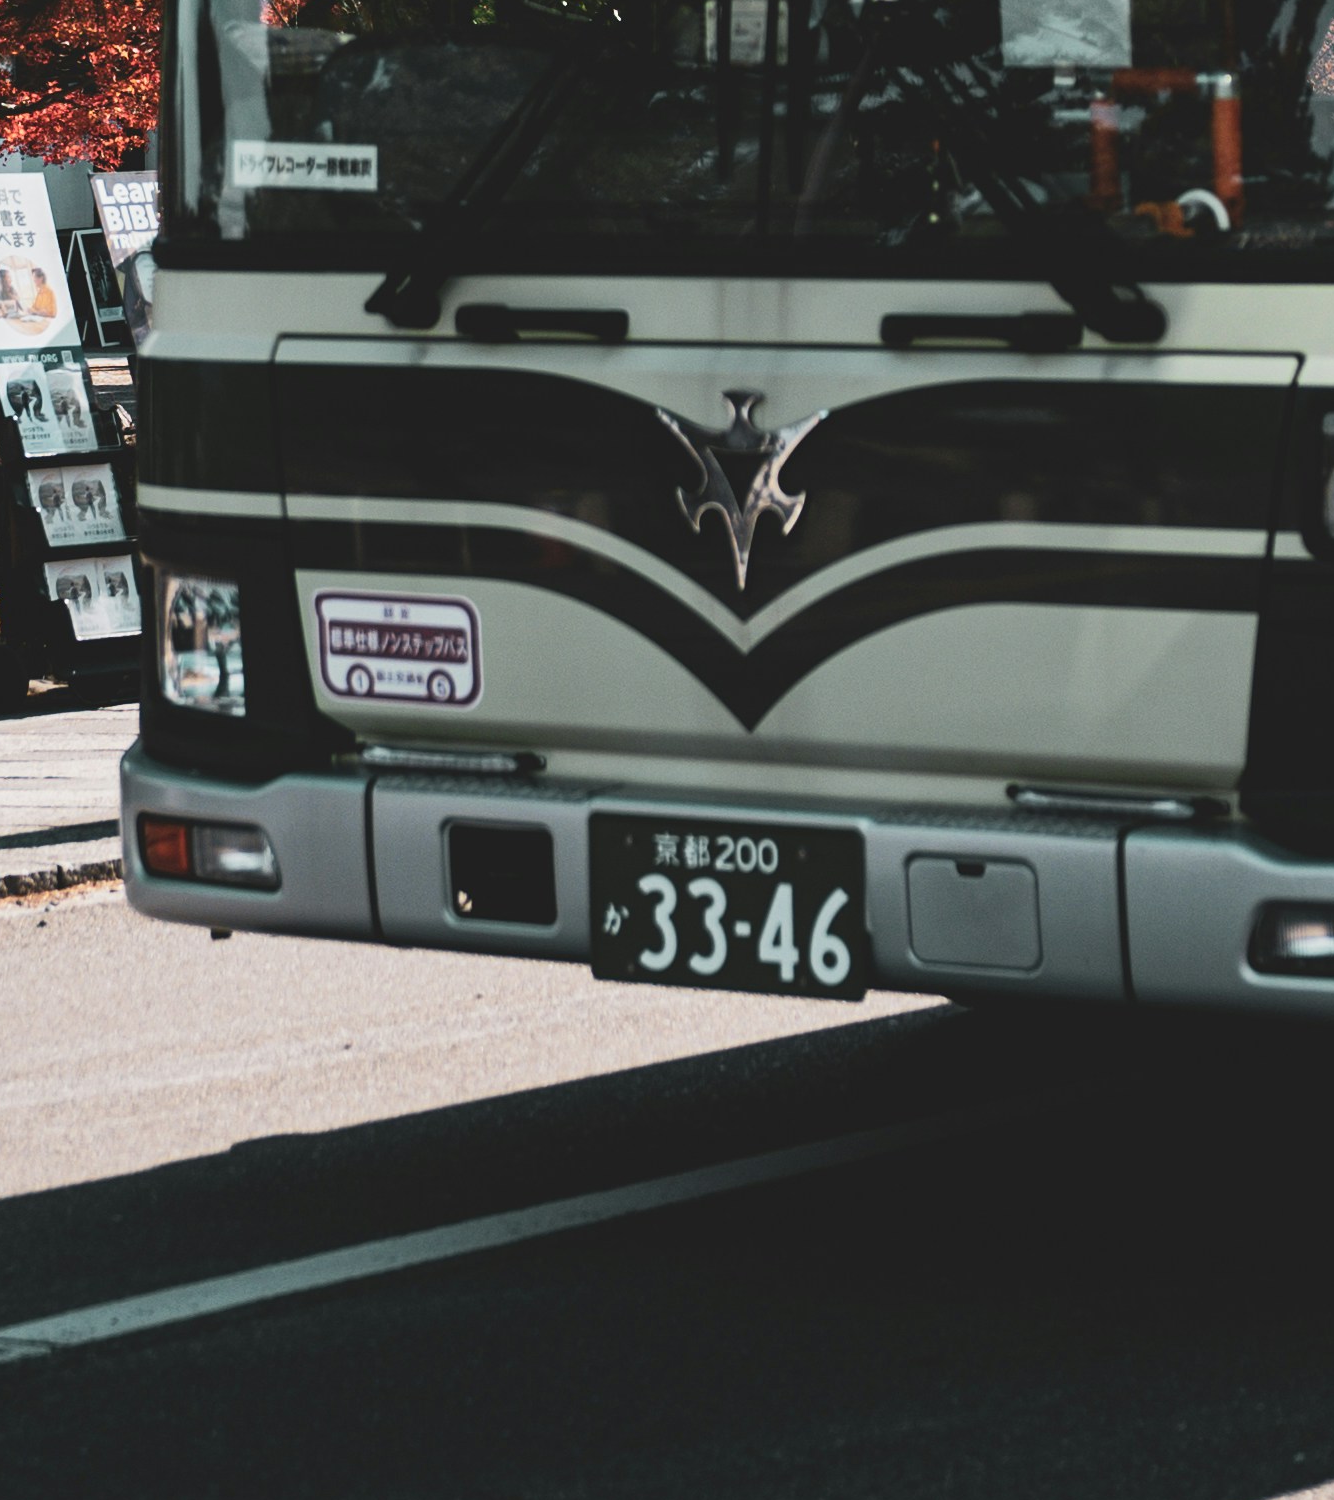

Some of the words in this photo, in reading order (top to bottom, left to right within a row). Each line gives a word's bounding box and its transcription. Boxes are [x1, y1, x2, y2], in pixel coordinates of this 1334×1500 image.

[102, 203, 159, 231] BIBL
[603, 902, 629, 936] か
[638, 873, 851, 986] 33-46
